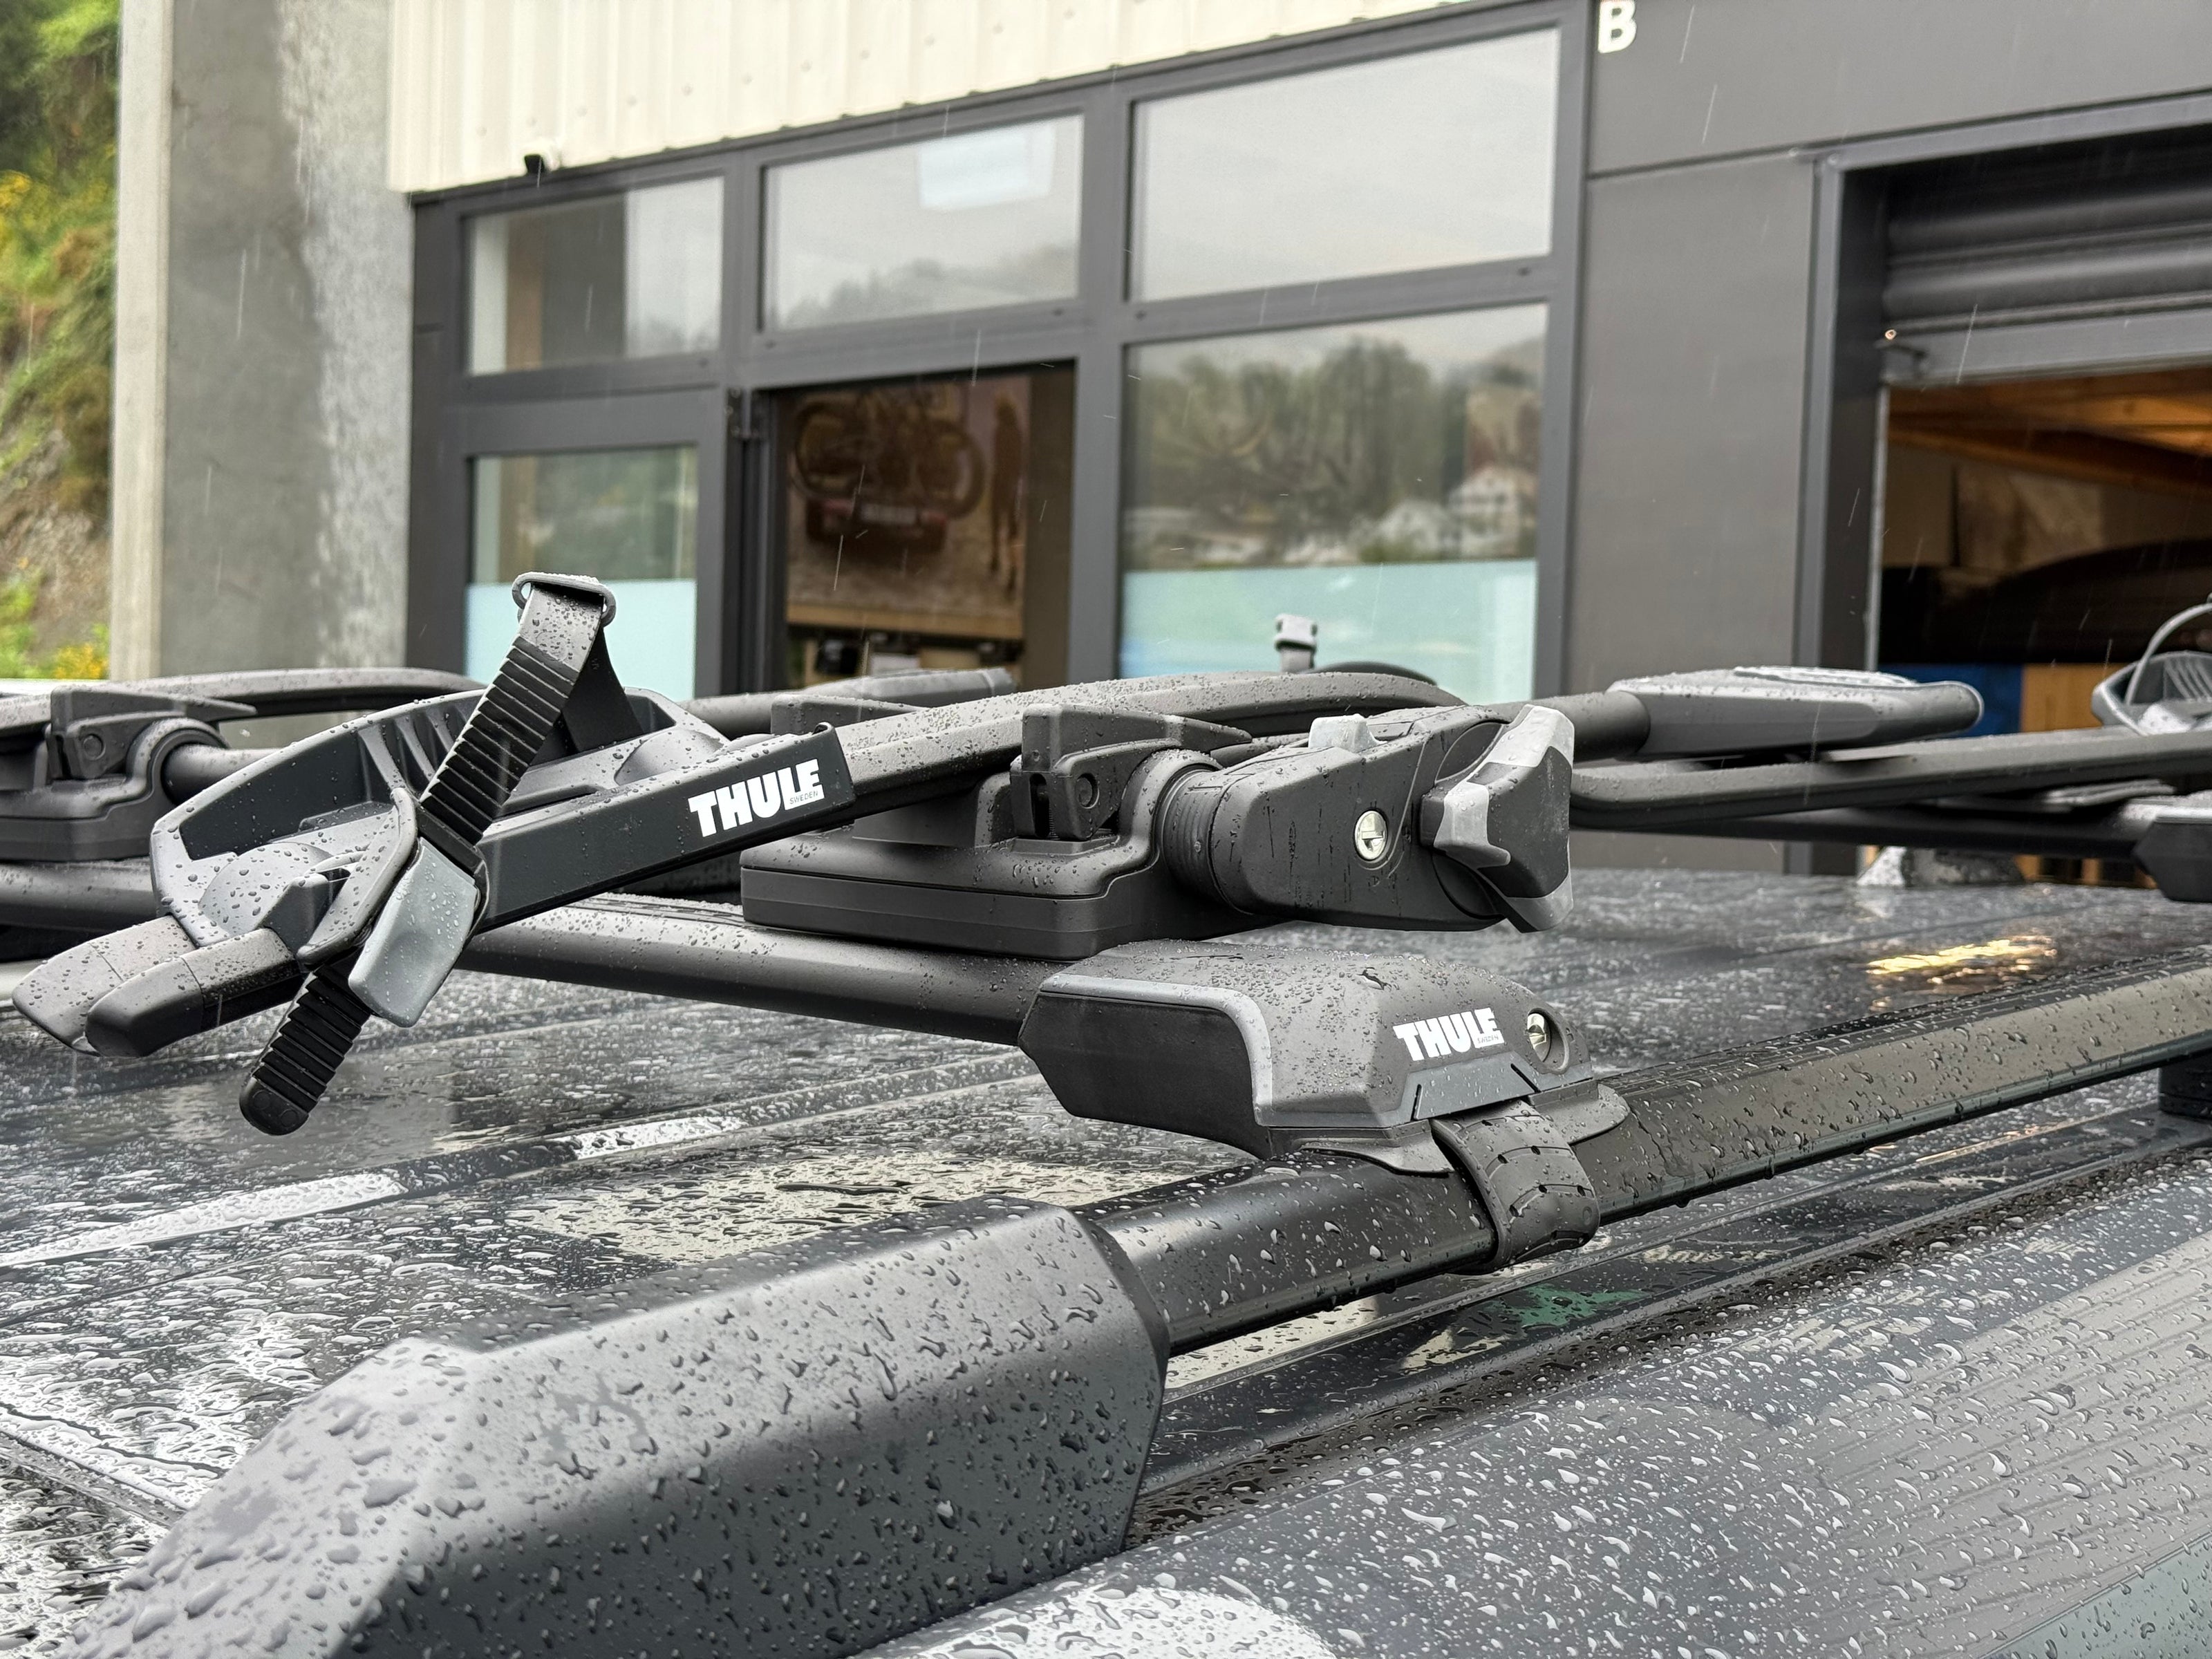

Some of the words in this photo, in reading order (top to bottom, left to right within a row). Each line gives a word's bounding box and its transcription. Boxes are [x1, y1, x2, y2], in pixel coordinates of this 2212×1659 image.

[1597, 0, 1637, 53] B
[688, 759, 825, 837] THULE
[789, 791, 818, 805] SWEDEN
[1392, 1007, 1505, 1061] THULE
